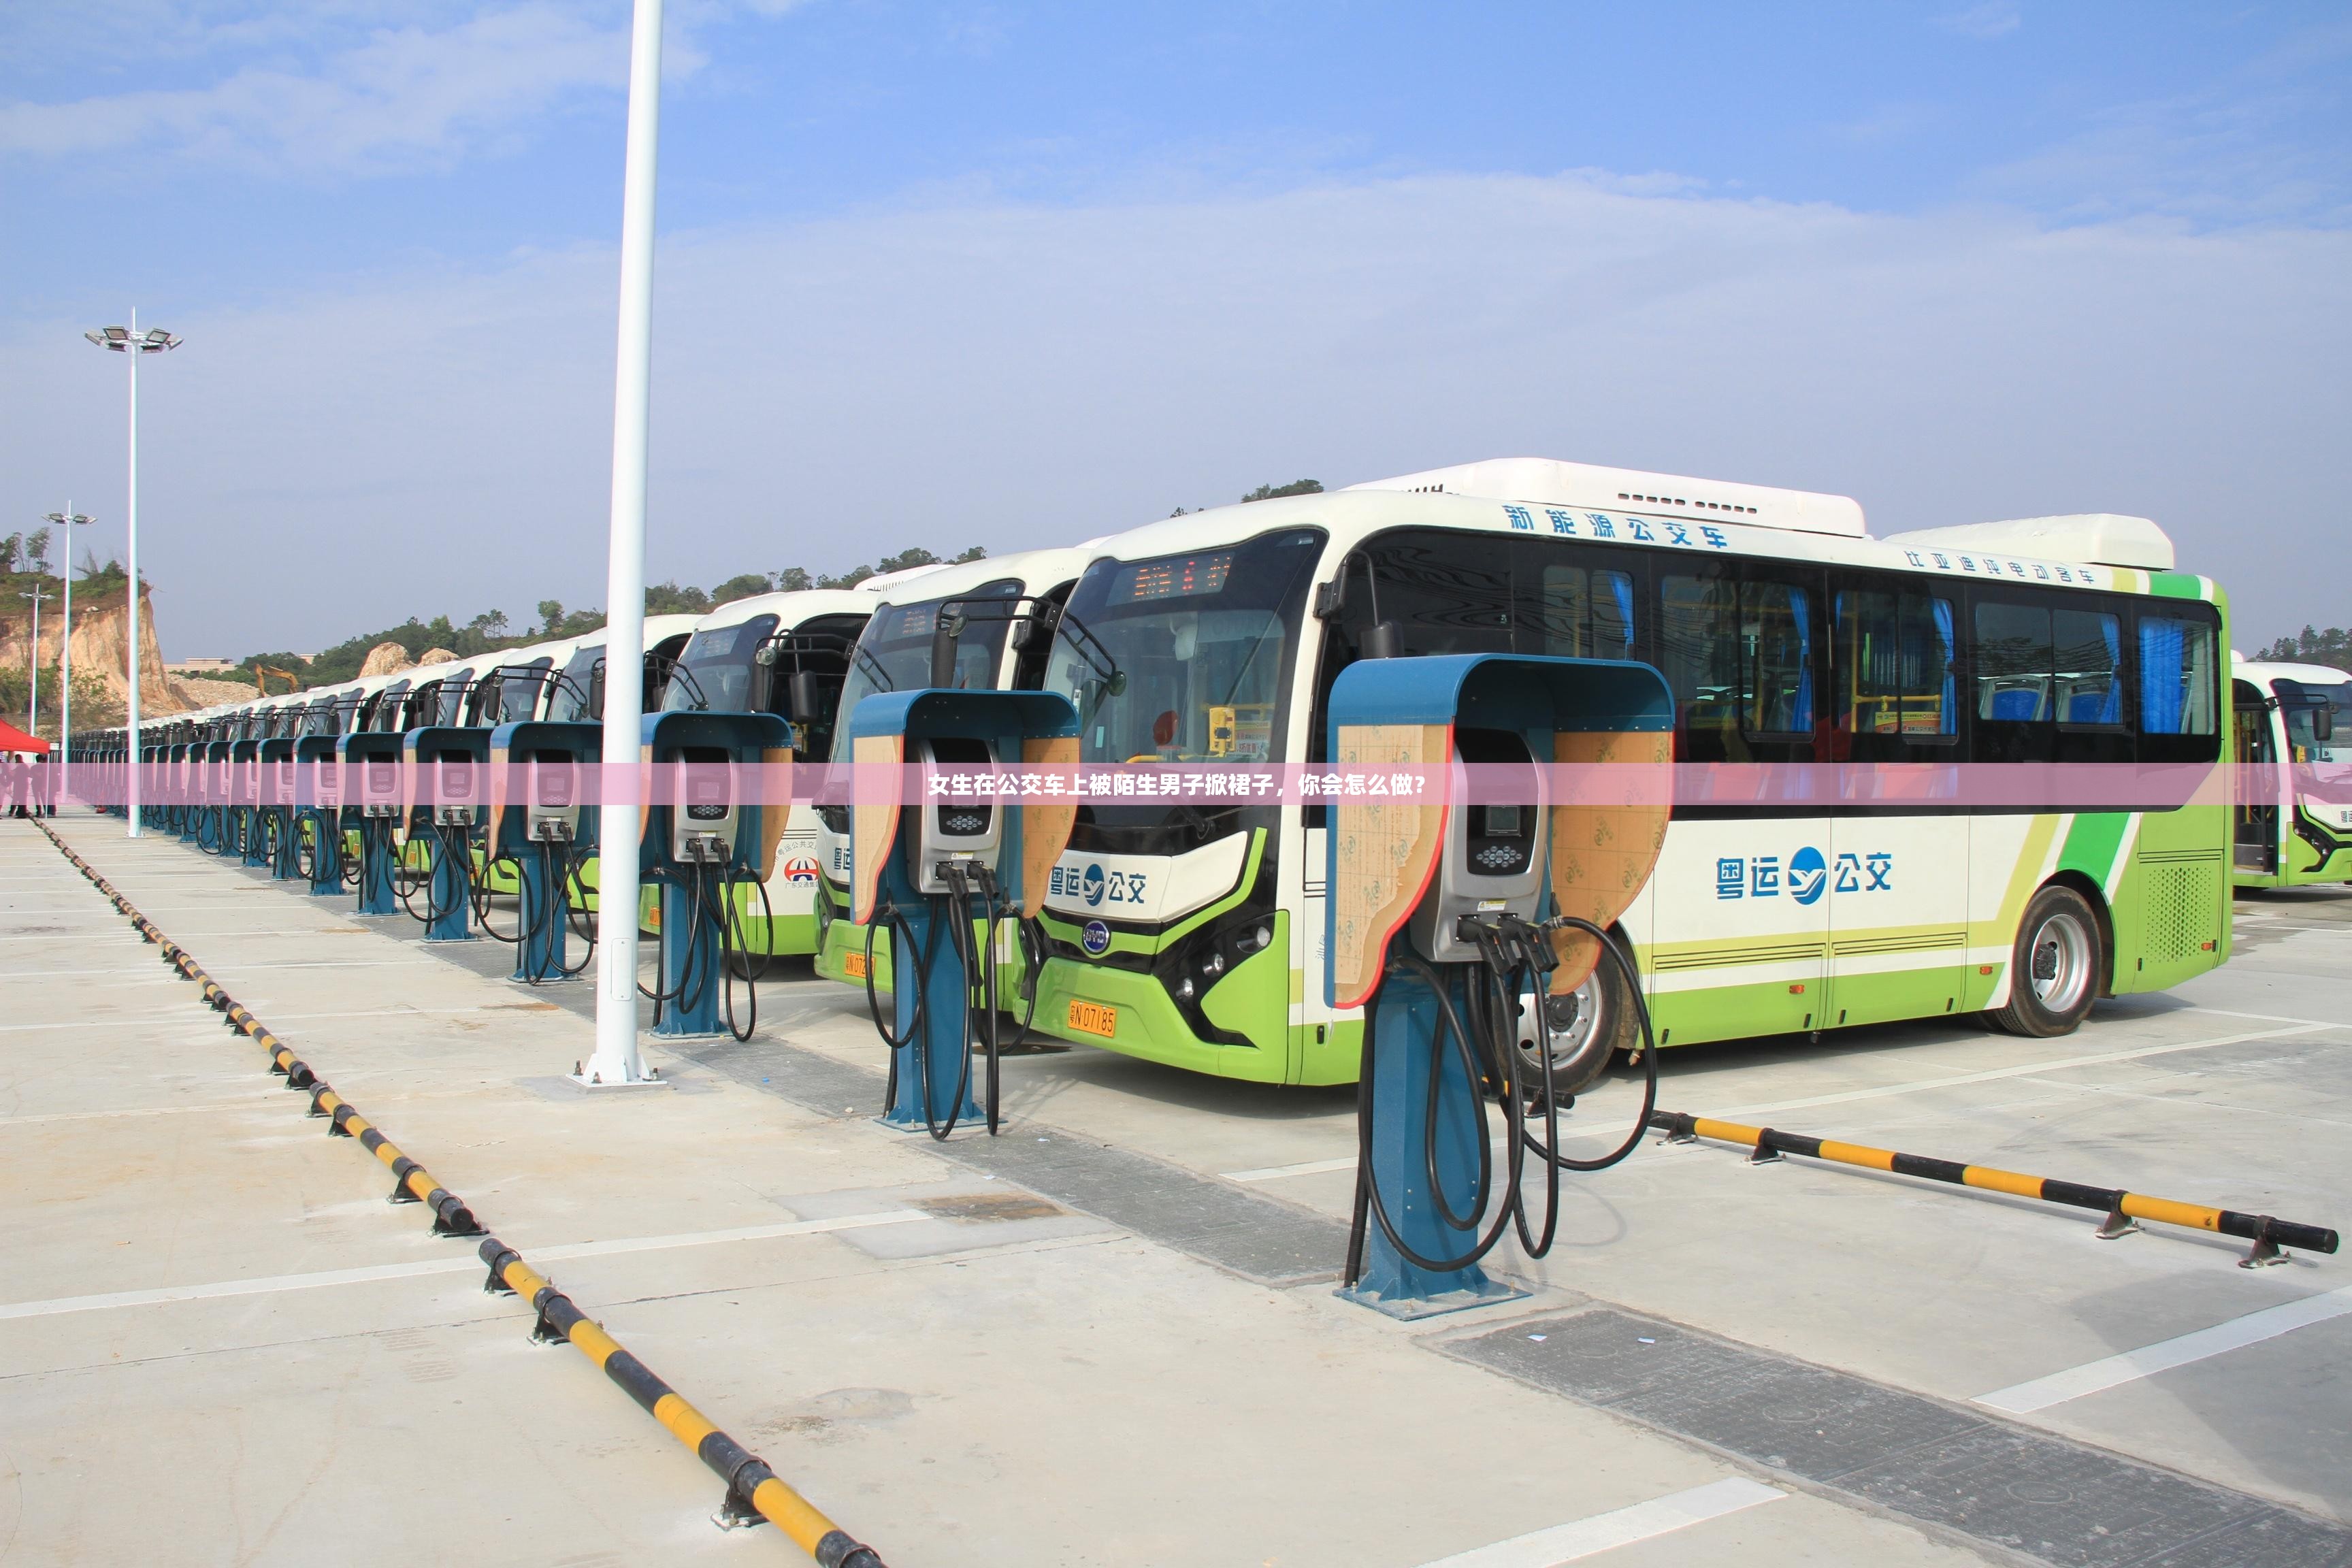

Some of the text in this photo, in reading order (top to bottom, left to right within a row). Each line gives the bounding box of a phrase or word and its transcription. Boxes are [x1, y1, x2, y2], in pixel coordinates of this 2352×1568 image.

[1502, 504, 1727, 549] 新能源公交车
[1904, 550, 2094, 584] 比亚迪纯电动客车
[1108, 871, 1147, 904] 公交
[1833, 852, 1892, 892] 公交
[1085, 928, 1105, 943] BYD
